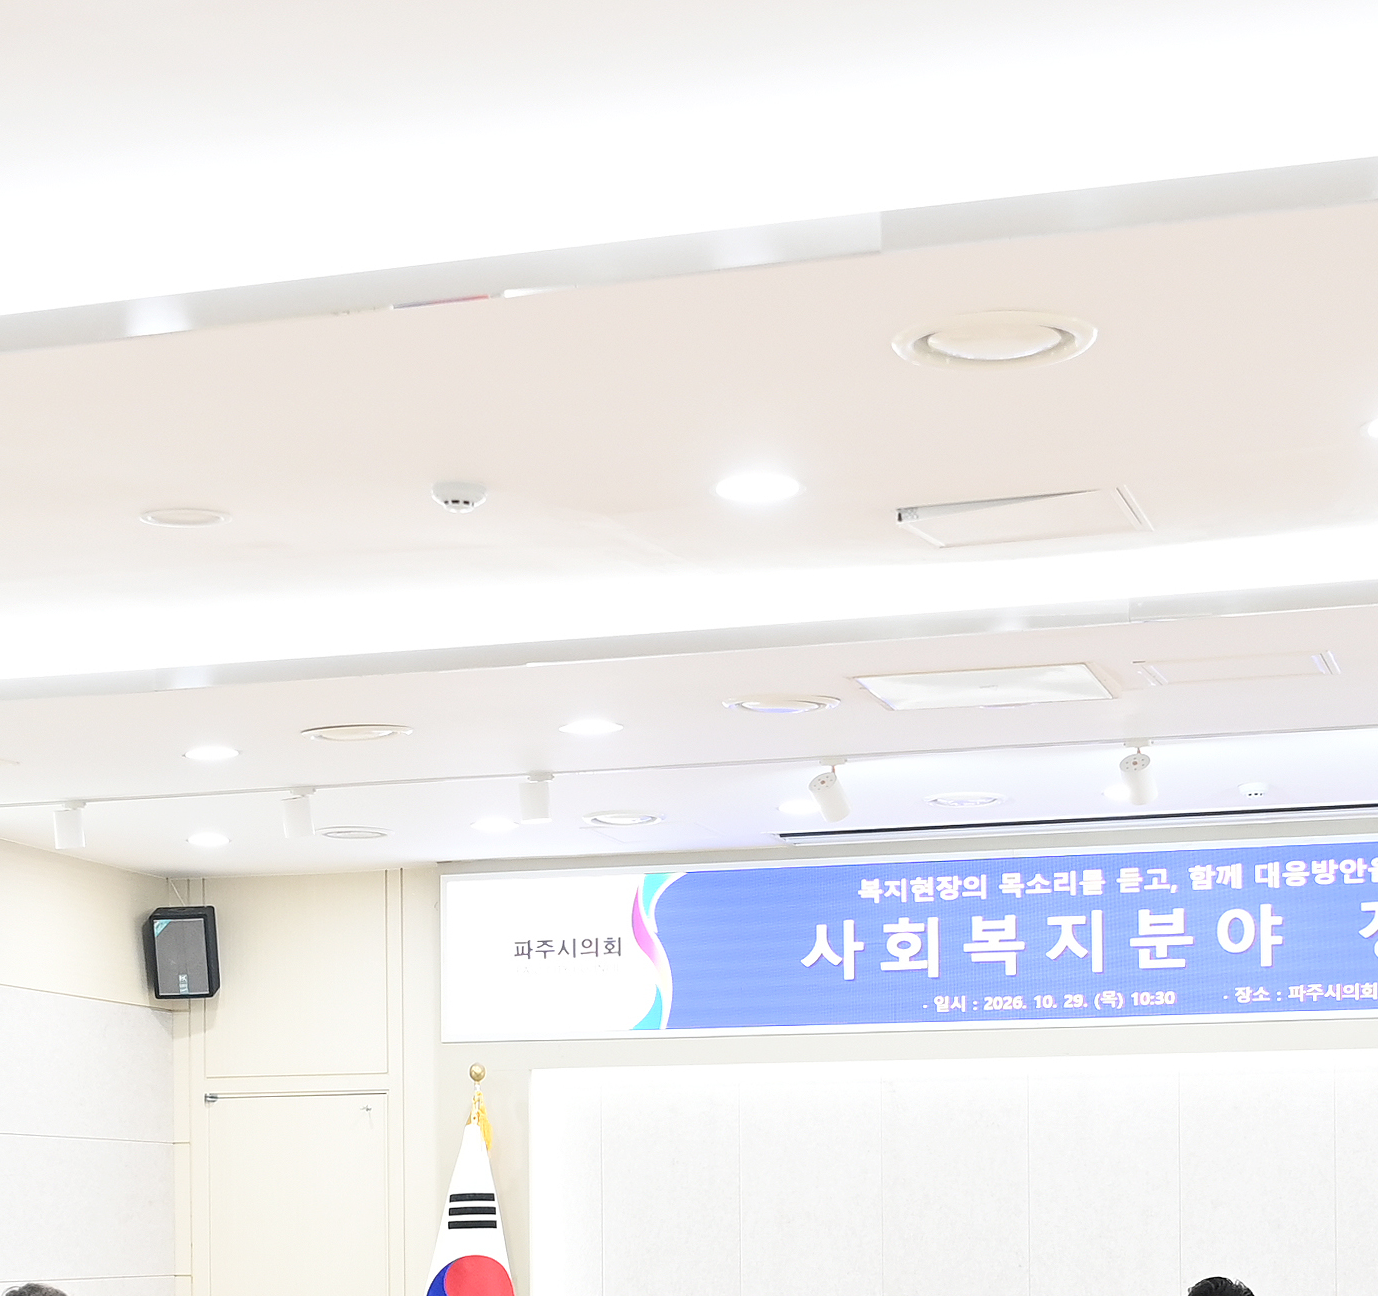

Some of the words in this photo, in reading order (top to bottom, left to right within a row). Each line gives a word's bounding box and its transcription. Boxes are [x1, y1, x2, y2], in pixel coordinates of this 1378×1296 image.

[857, 873, 988, 904] 복지현장의
[998, 868, 1107, 898] 목소리를
[1116, 866, 1178, 894] 듣고,
[1187, 862, 1243, 891] 함께
[513, 936, 622, 960] 파주시의회
[800, 903, 1284, 981] 사회복지분야
[933, 995, 966, 1013] 일시
[983, 995, 1027, 1011] 2026.
[1033, 994, 1058, 1009] 10.
[1063, 993, 1088, 1008] 29.
[1093, 990, 1124, 1010] (목)
[1130, 990, 1177, 1006] 10:30
[1234, 986, 1271, 1003] 장소
[1287, 982, 1378, 1002] 파주시의회
